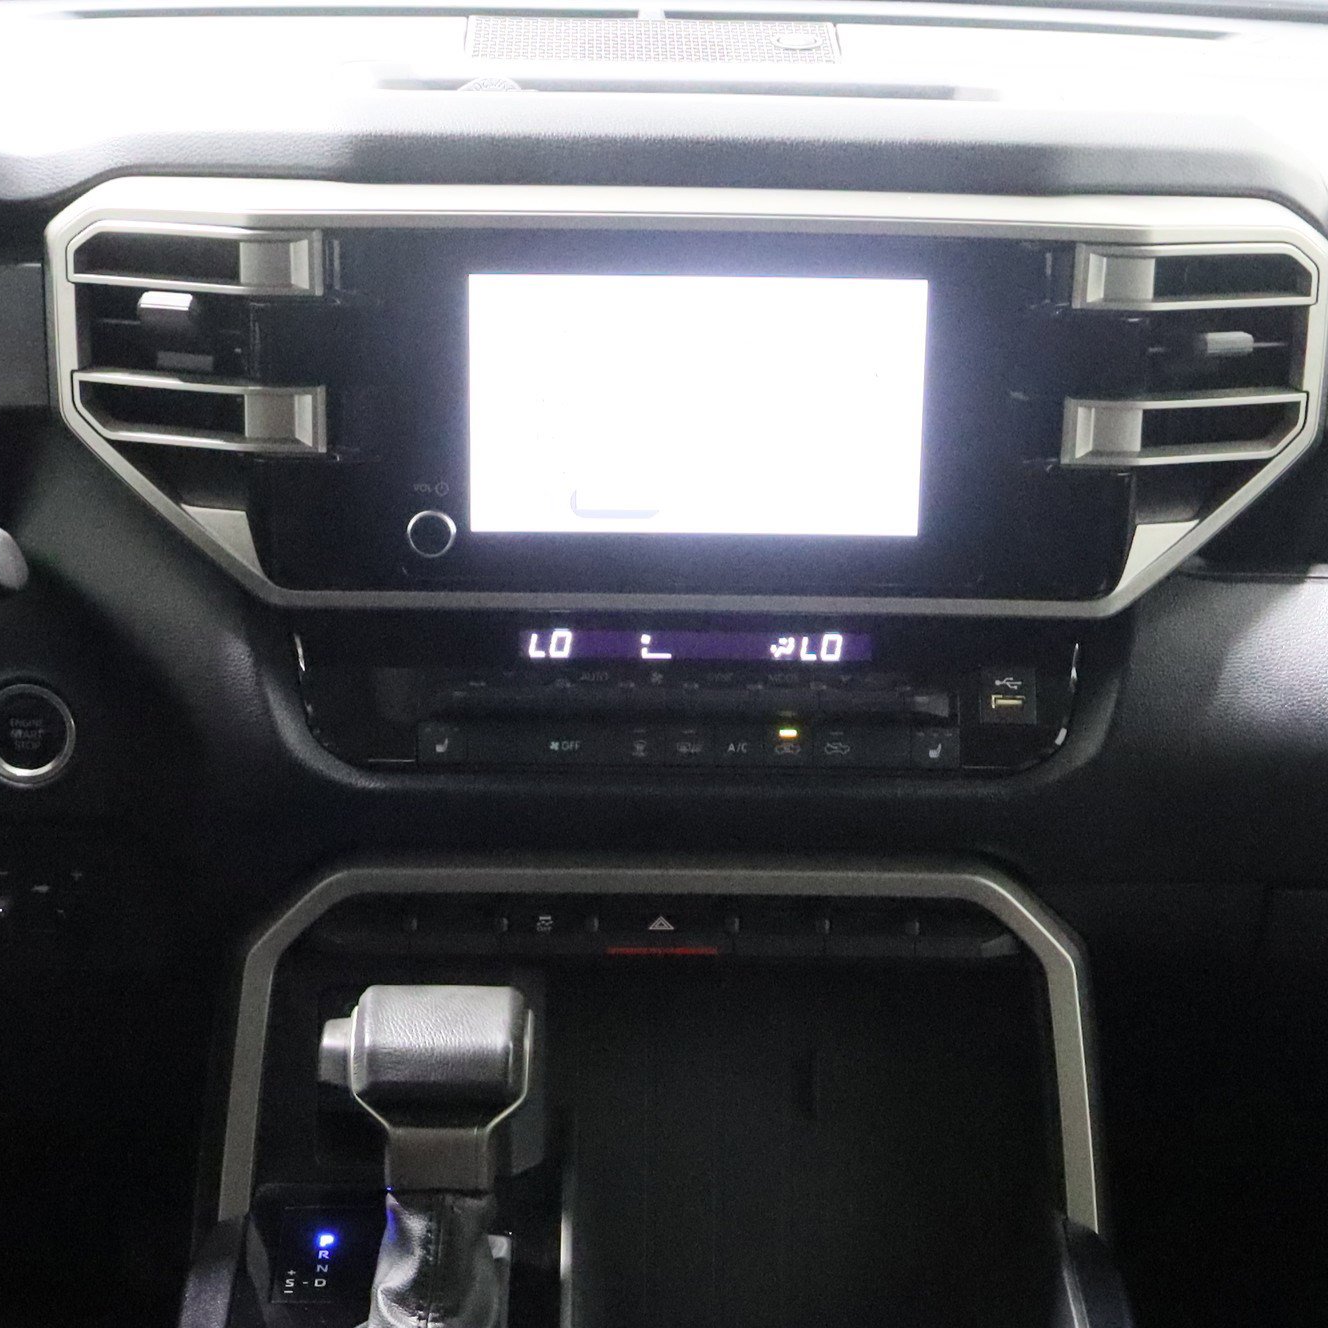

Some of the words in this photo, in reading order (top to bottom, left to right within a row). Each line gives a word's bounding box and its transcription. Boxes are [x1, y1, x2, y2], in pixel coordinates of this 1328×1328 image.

[561, 741, 581, 750] OFF
[727, 742, 748, 754] A/C
[319, 1234, 335, 1247] P
[318, 1250, 330, 1259] R
[316, 1264, 329, 1273] N
[285, 1278, 295, 1288] S
[314, 1278, 327, 1288] D
